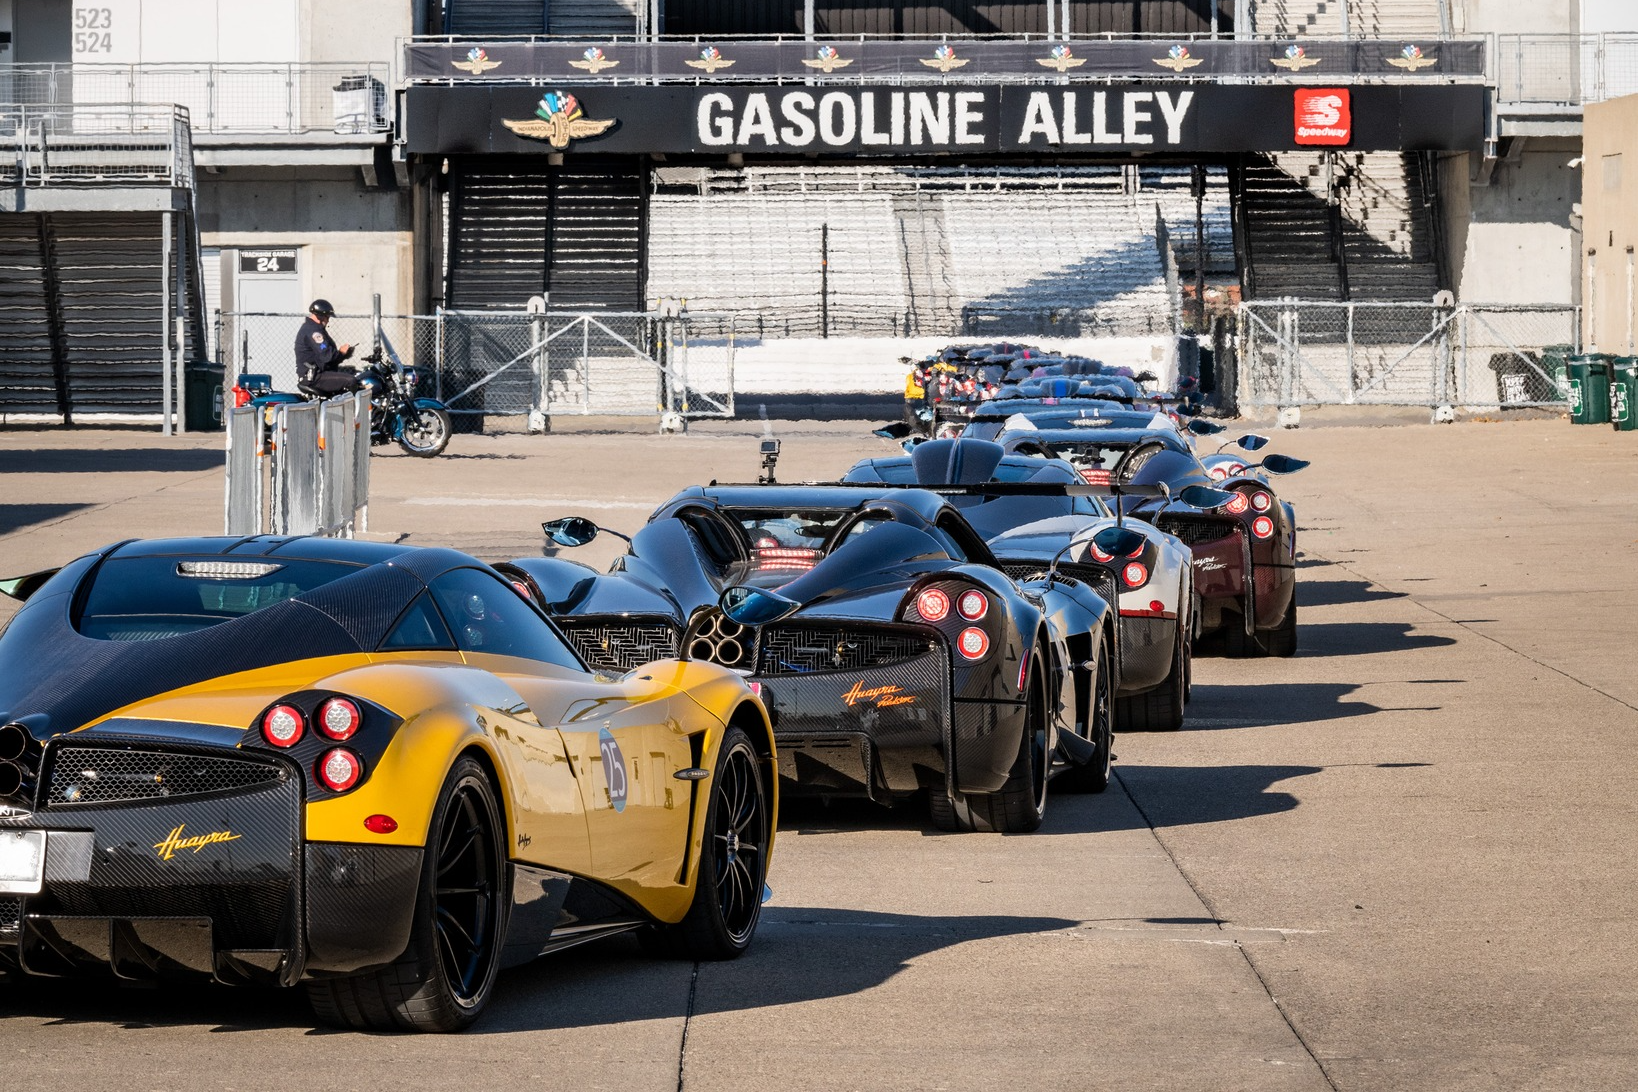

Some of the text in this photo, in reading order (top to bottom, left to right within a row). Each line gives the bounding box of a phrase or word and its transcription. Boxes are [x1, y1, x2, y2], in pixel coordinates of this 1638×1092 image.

[75, 8, 111, 29] 523
[75, 32, 112, 53] 524
[697, 91, 1194, 146] GASOLINE ALLEY
[1297, 127, 1347, 138] Speedway
[257, 257, 279, 271] 24
[841, 680, 904, 706] Huayra
[601, 742, 625, 797] 25
[153, 823, 242, 860] Huayra
